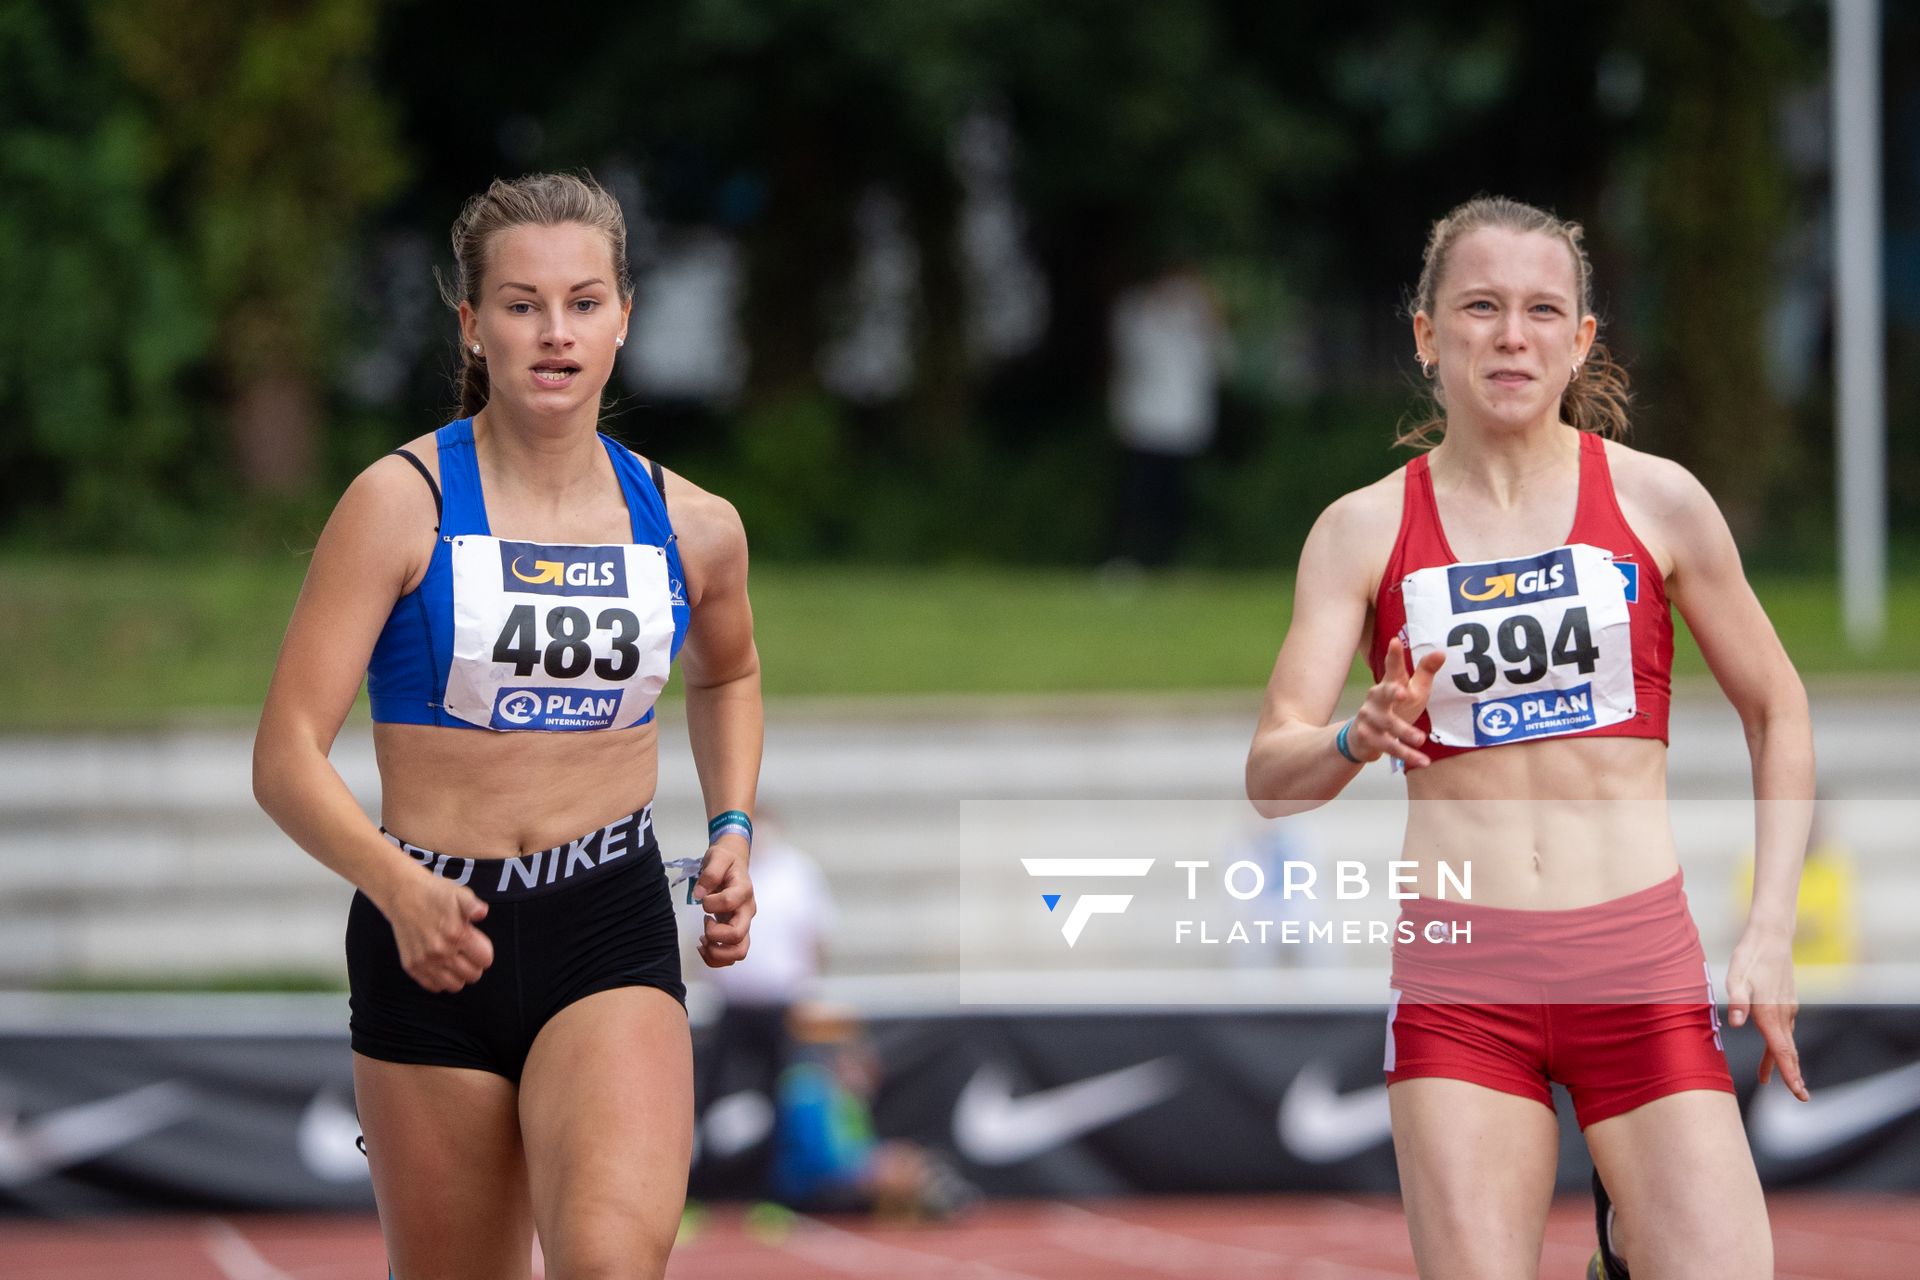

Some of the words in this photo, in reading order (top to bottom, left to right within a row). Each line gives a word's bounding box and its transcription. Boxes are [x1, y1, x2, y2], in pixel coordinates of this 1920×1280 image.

[565, 561, 615, 587] GLS
[1516, 563, 1565, 595] GLS
[491, 604, 641, 682] 483
[1446, 606, 1600, 694] 394
[546, 694, 617, 717] PLAN
[1521, 692, 1589, 721] PLAN
[545, 717, 609, 727] INTERNATIONAL
[1525, 714, 1591, 731] INTERNATIONAL
[496, 813, 634, 892] NIKE
